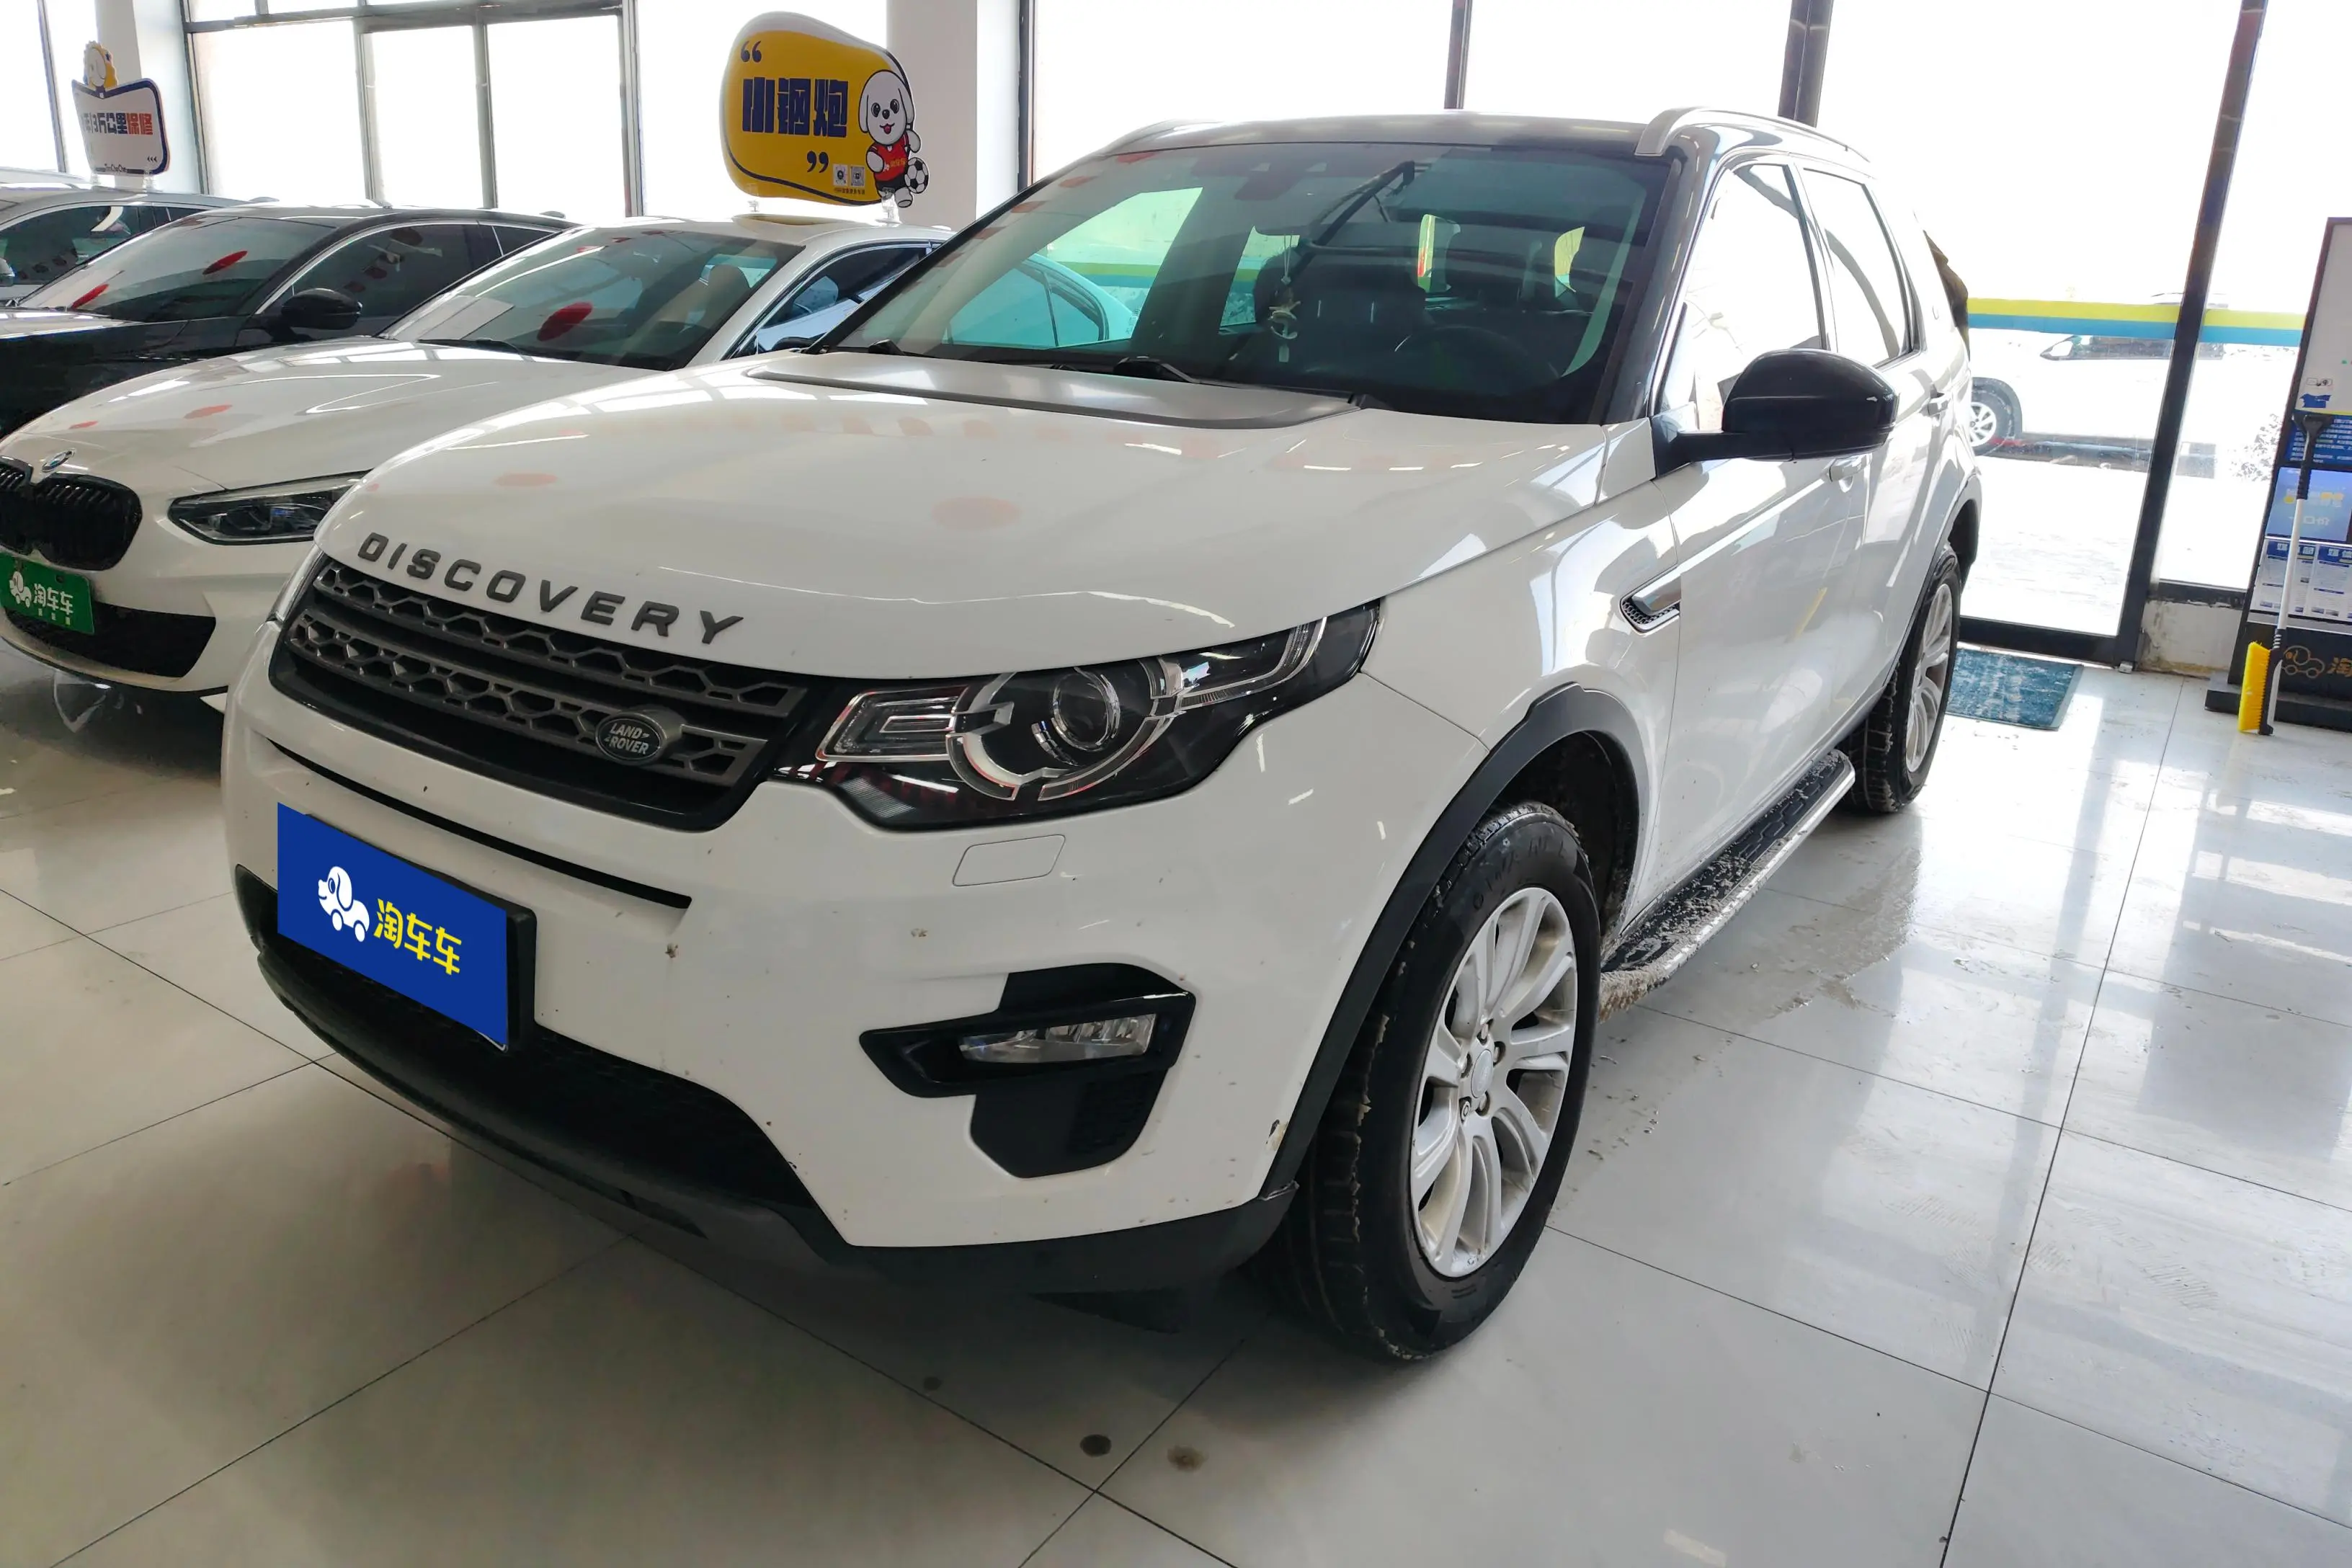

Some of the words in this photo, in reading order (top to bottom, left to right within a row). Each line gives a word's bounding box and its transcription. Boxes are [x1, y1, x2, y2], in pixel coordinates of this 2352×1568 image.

[742, 76, 848, 138] 小钢炮
[33, 583, 74, 615] 淘车车
[357, 532, 744, 645] DISCOVERY
[608, 736, 649, 755] ROVER
[610, 723, 643, 739] LAND
